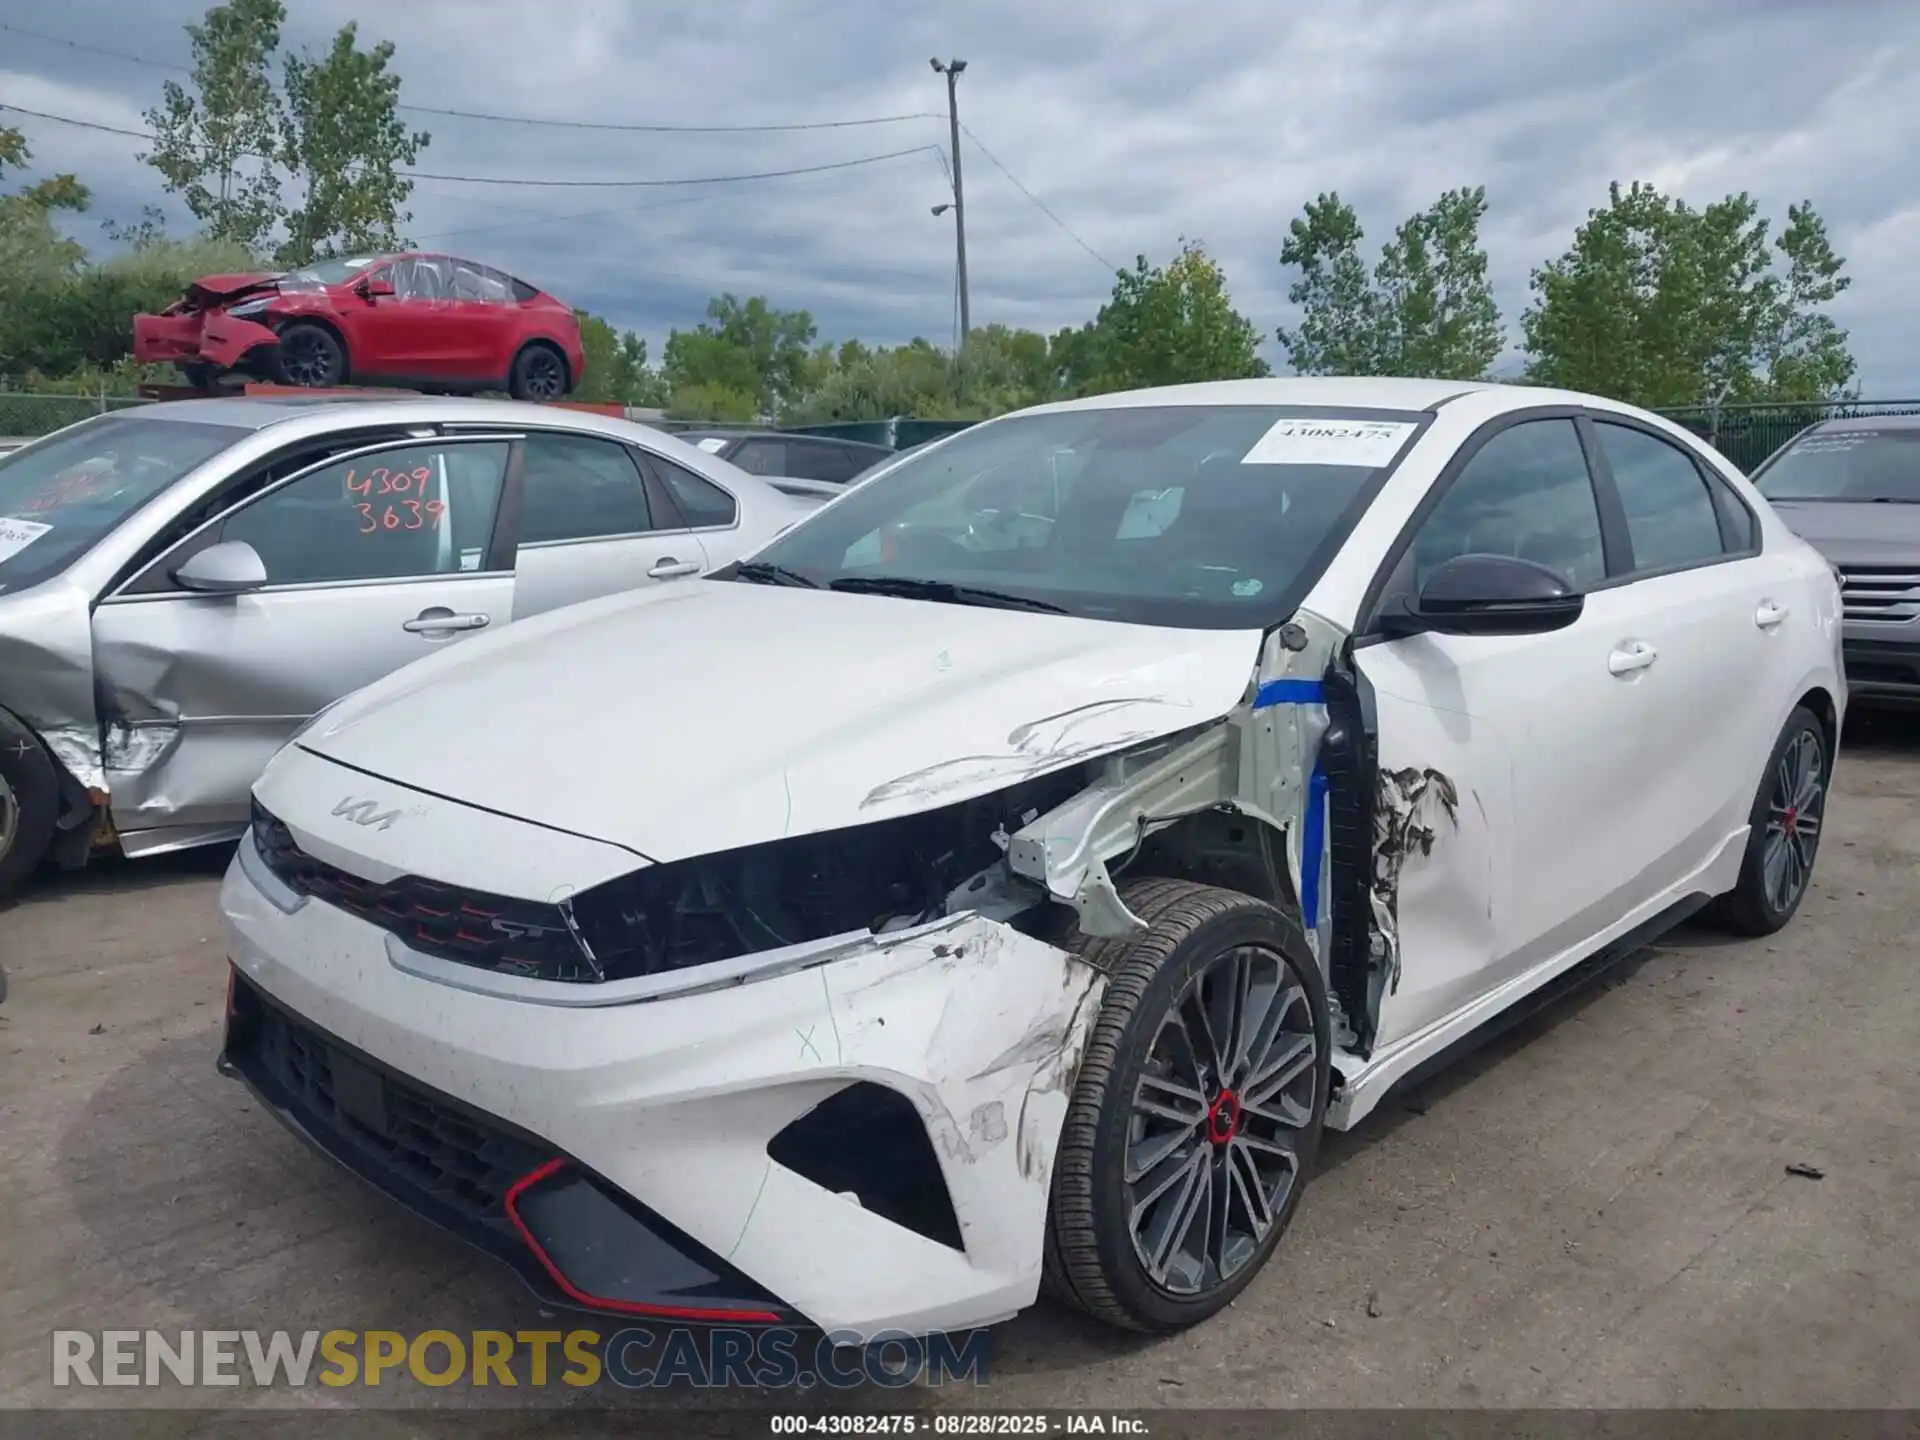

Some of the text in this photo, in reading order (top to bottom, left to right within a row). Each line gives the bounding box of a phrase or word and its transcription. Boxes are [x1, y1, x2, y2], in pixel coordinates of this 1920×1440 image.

[1280, 427, 1392, 440] 43082475
[347, 467, 430, 496] 4309
[353, 499, 445, 533] 3639
